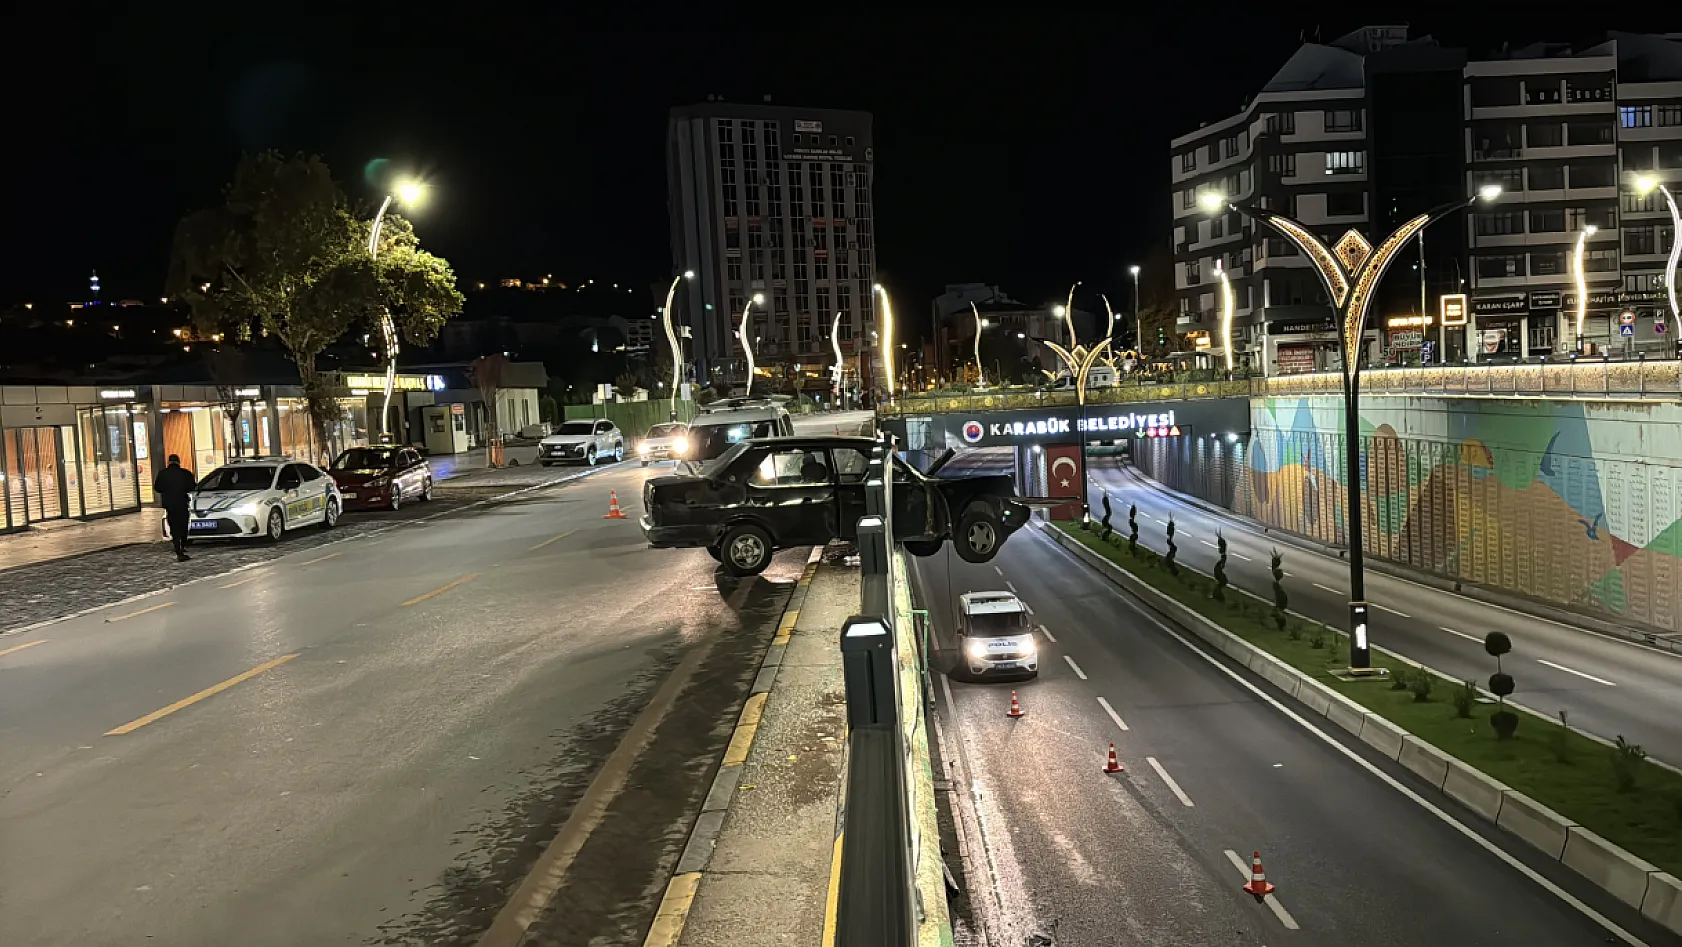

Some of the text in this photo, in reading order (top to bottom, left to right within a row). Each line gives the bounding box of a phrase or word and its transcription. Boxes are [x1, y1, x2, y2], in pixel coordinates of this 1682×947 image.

[1476, 302, 1502, 310] KARAN
[989, 409, 1175, 436] KARABÜK BELEDİYESİ
